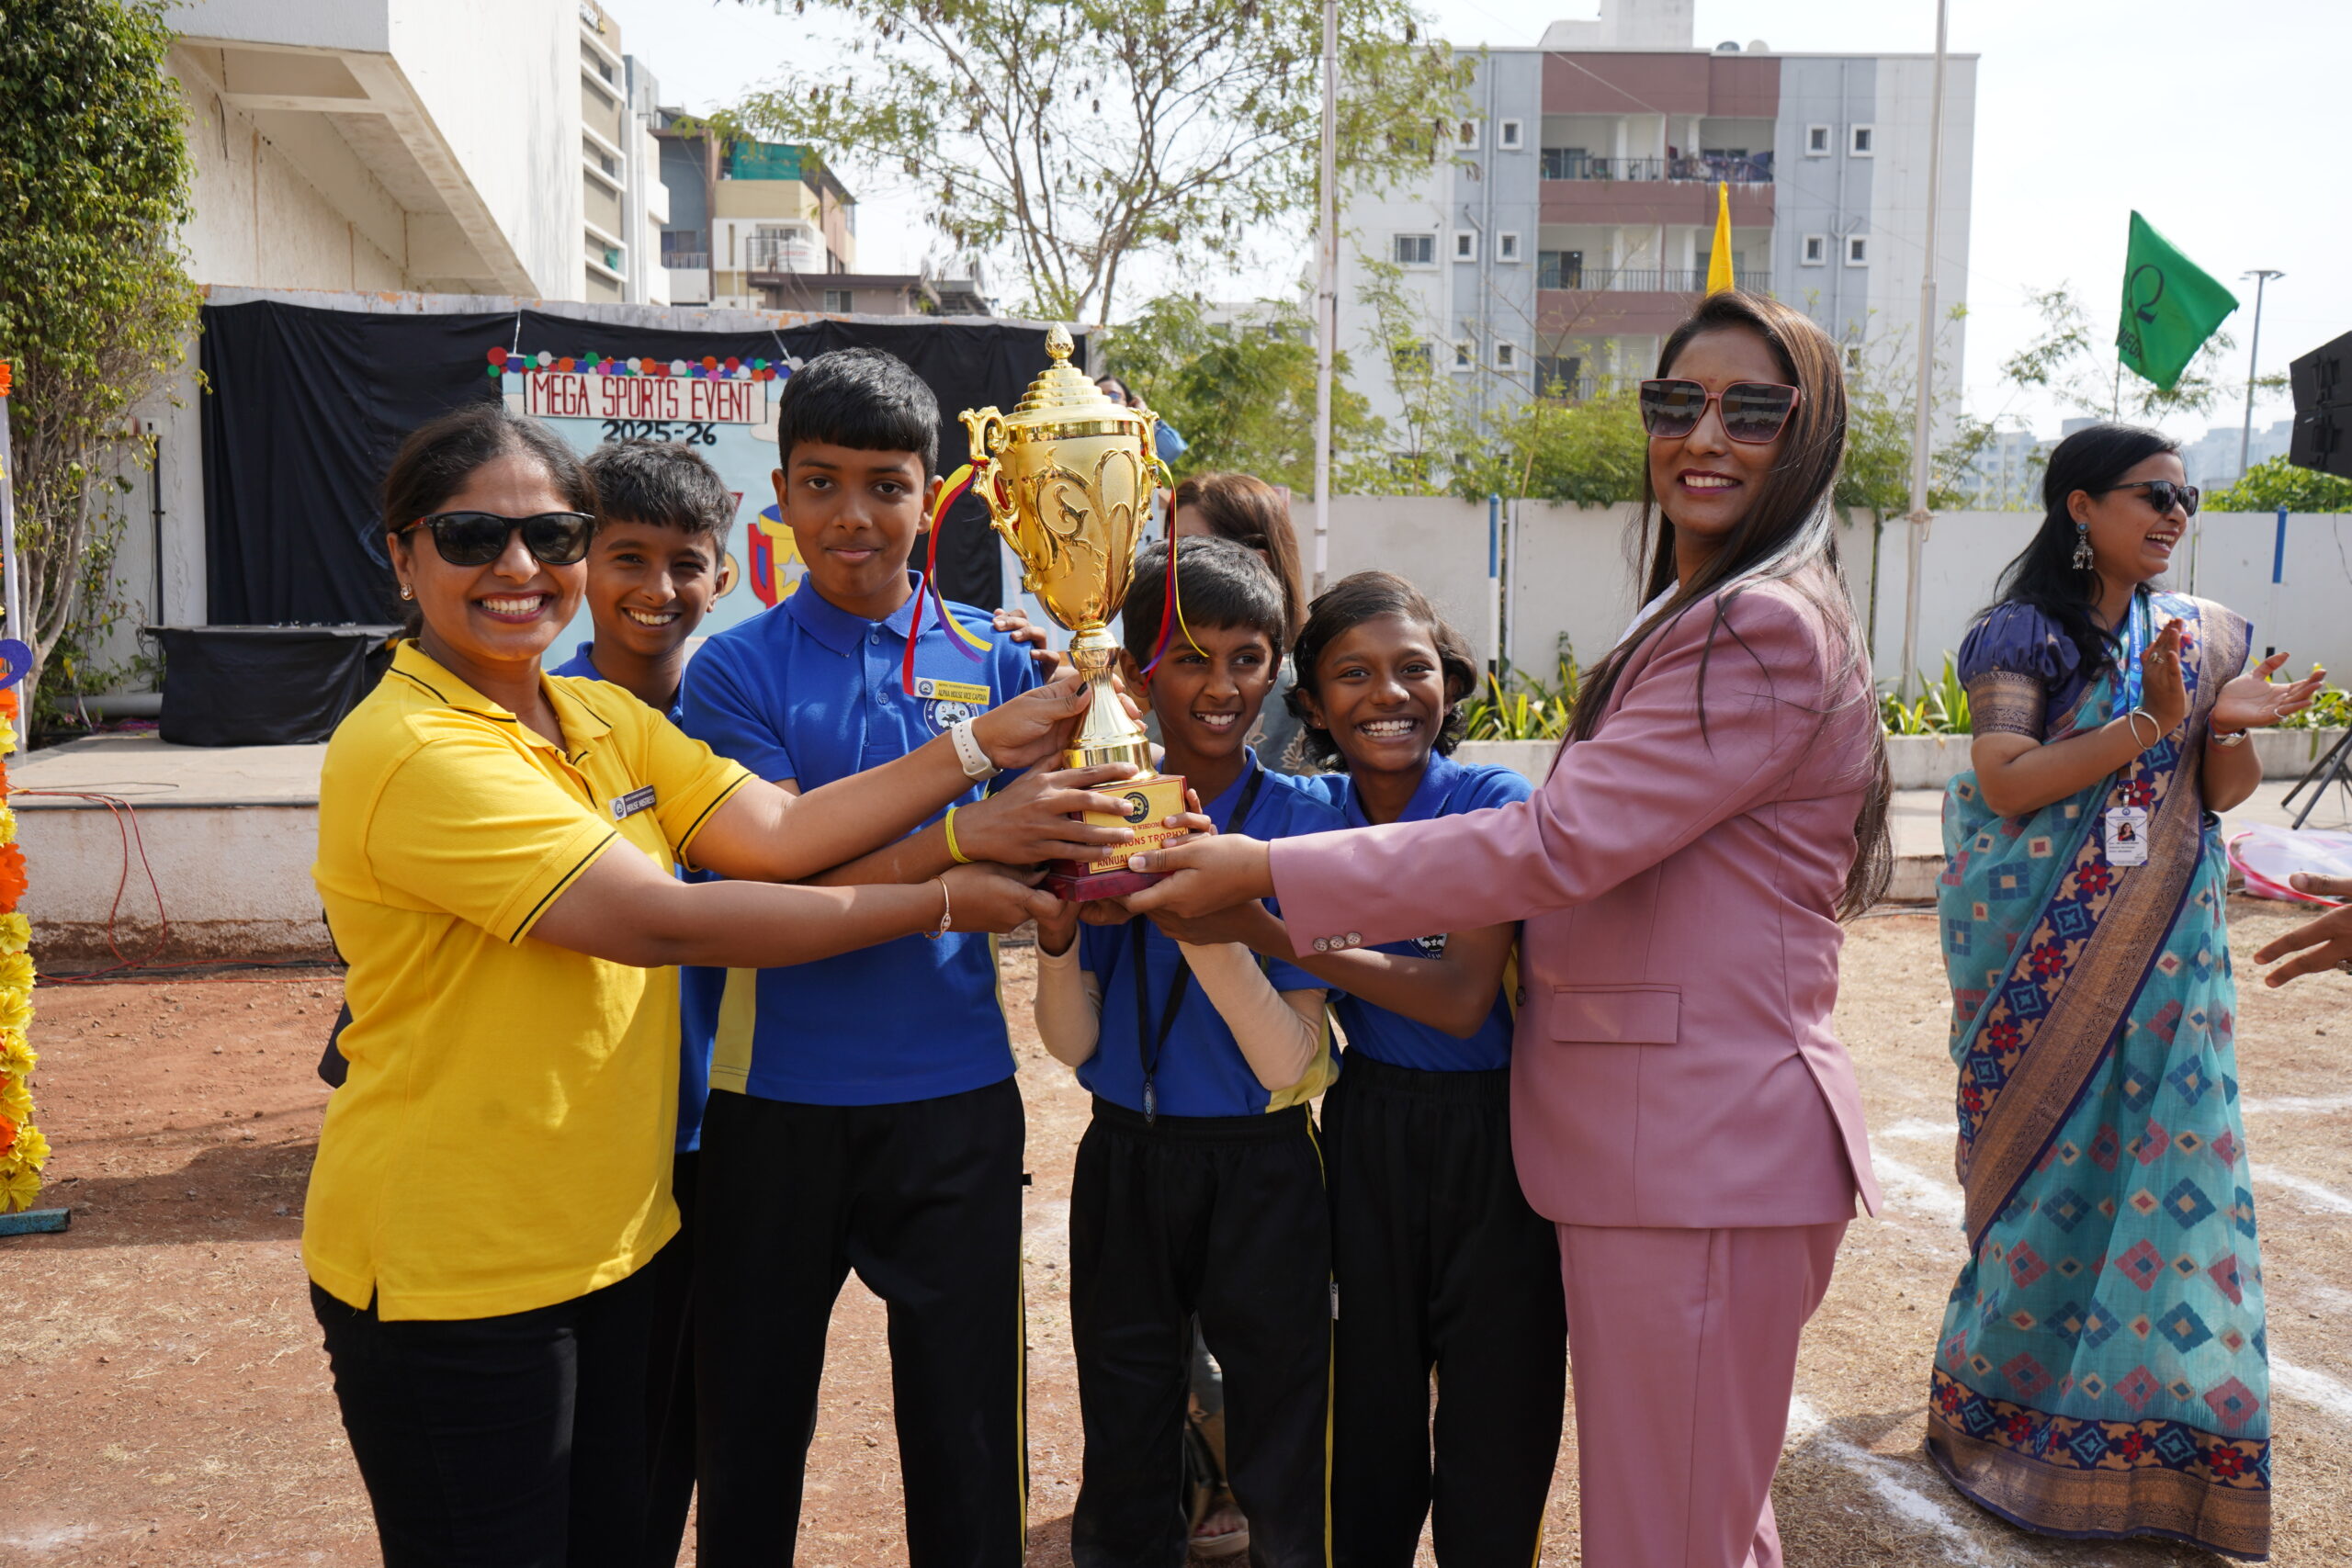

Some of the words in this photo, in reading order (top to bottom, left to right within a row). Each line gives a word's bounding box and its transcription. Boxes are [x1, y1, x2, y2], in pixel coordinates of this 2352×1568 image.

[532, 373, 591, 416] MEGA
[602, 376, 679, 420] SPORTS
[691, 380, 755, 423] EVENT
[601, 420, 717, 446] 2025-26
[950, 690, 963, 698] HOUSE
[1148, 829, 1184, 843] TROPHY
[1097, 853, 1128, 868] ANNUAL
